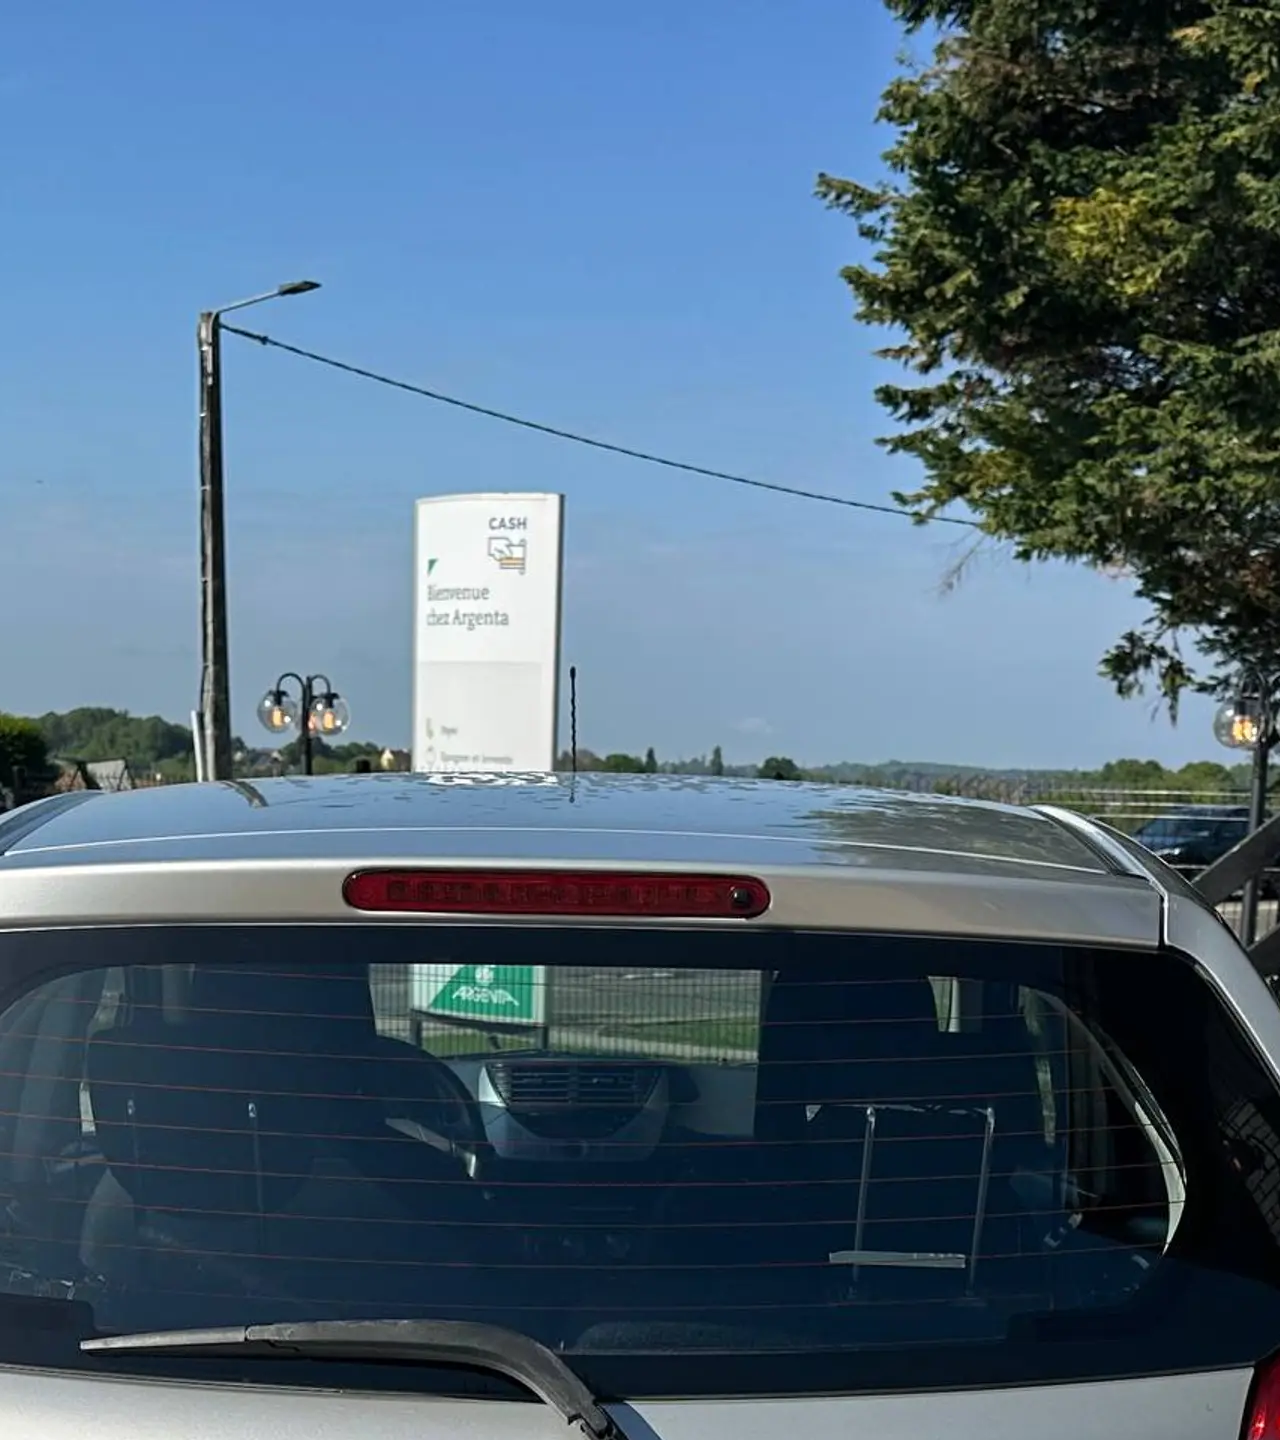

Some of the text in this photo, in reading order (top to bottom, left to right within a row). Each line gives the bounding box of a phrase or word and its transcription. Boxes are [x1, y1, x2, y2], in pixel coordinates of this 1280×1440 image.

[488, 517, 527, 530] CASH
[427, 585, 490, 601] Bienvenue
[427, 608, 509, 631] chez Argenta
